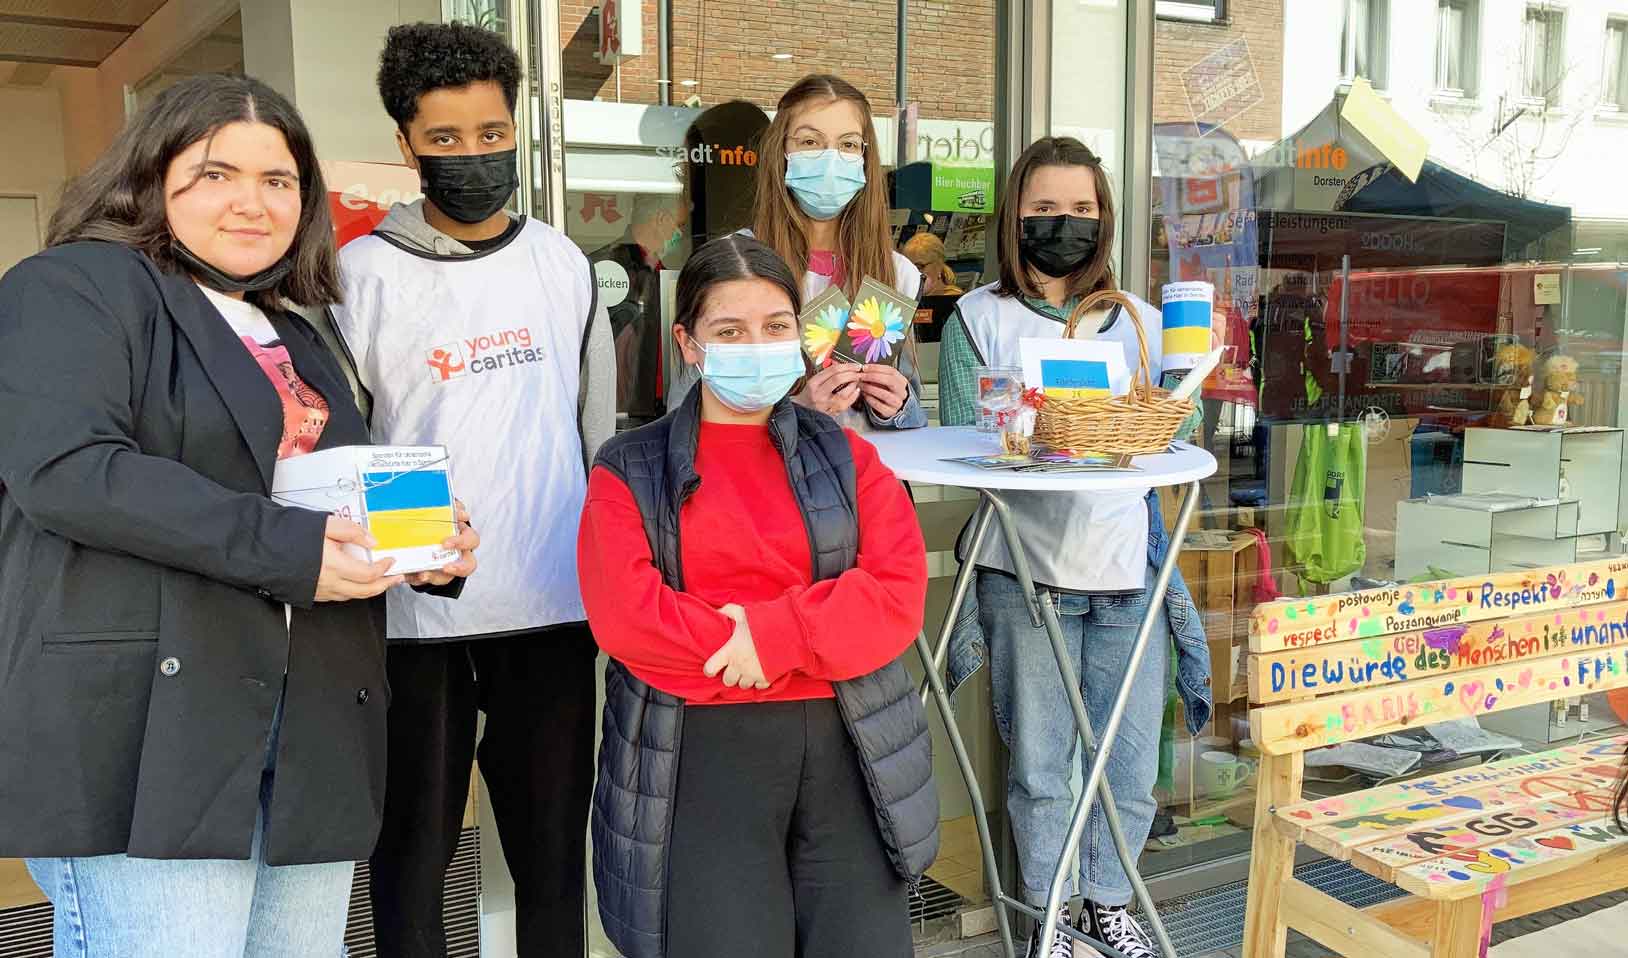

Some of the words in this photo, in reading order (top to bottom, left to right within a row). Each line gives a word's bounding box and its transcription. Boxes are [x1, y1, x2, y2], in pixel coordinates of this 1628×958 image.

[1313, 175, 1346, 187] Dorsten
[598, 277, 628, 288] ücken
[465, 327, 532, 359] young
[470, 346, 544, 374] caritas
[1338, 589, 1400, 613] poštovanje
[1480, 582, 1548, 610] Respekt
[1284, 619, 1337, 647] respect
[1414, 645, 1451, 670] des
[1457, 633, 1540, 668] Menschen
